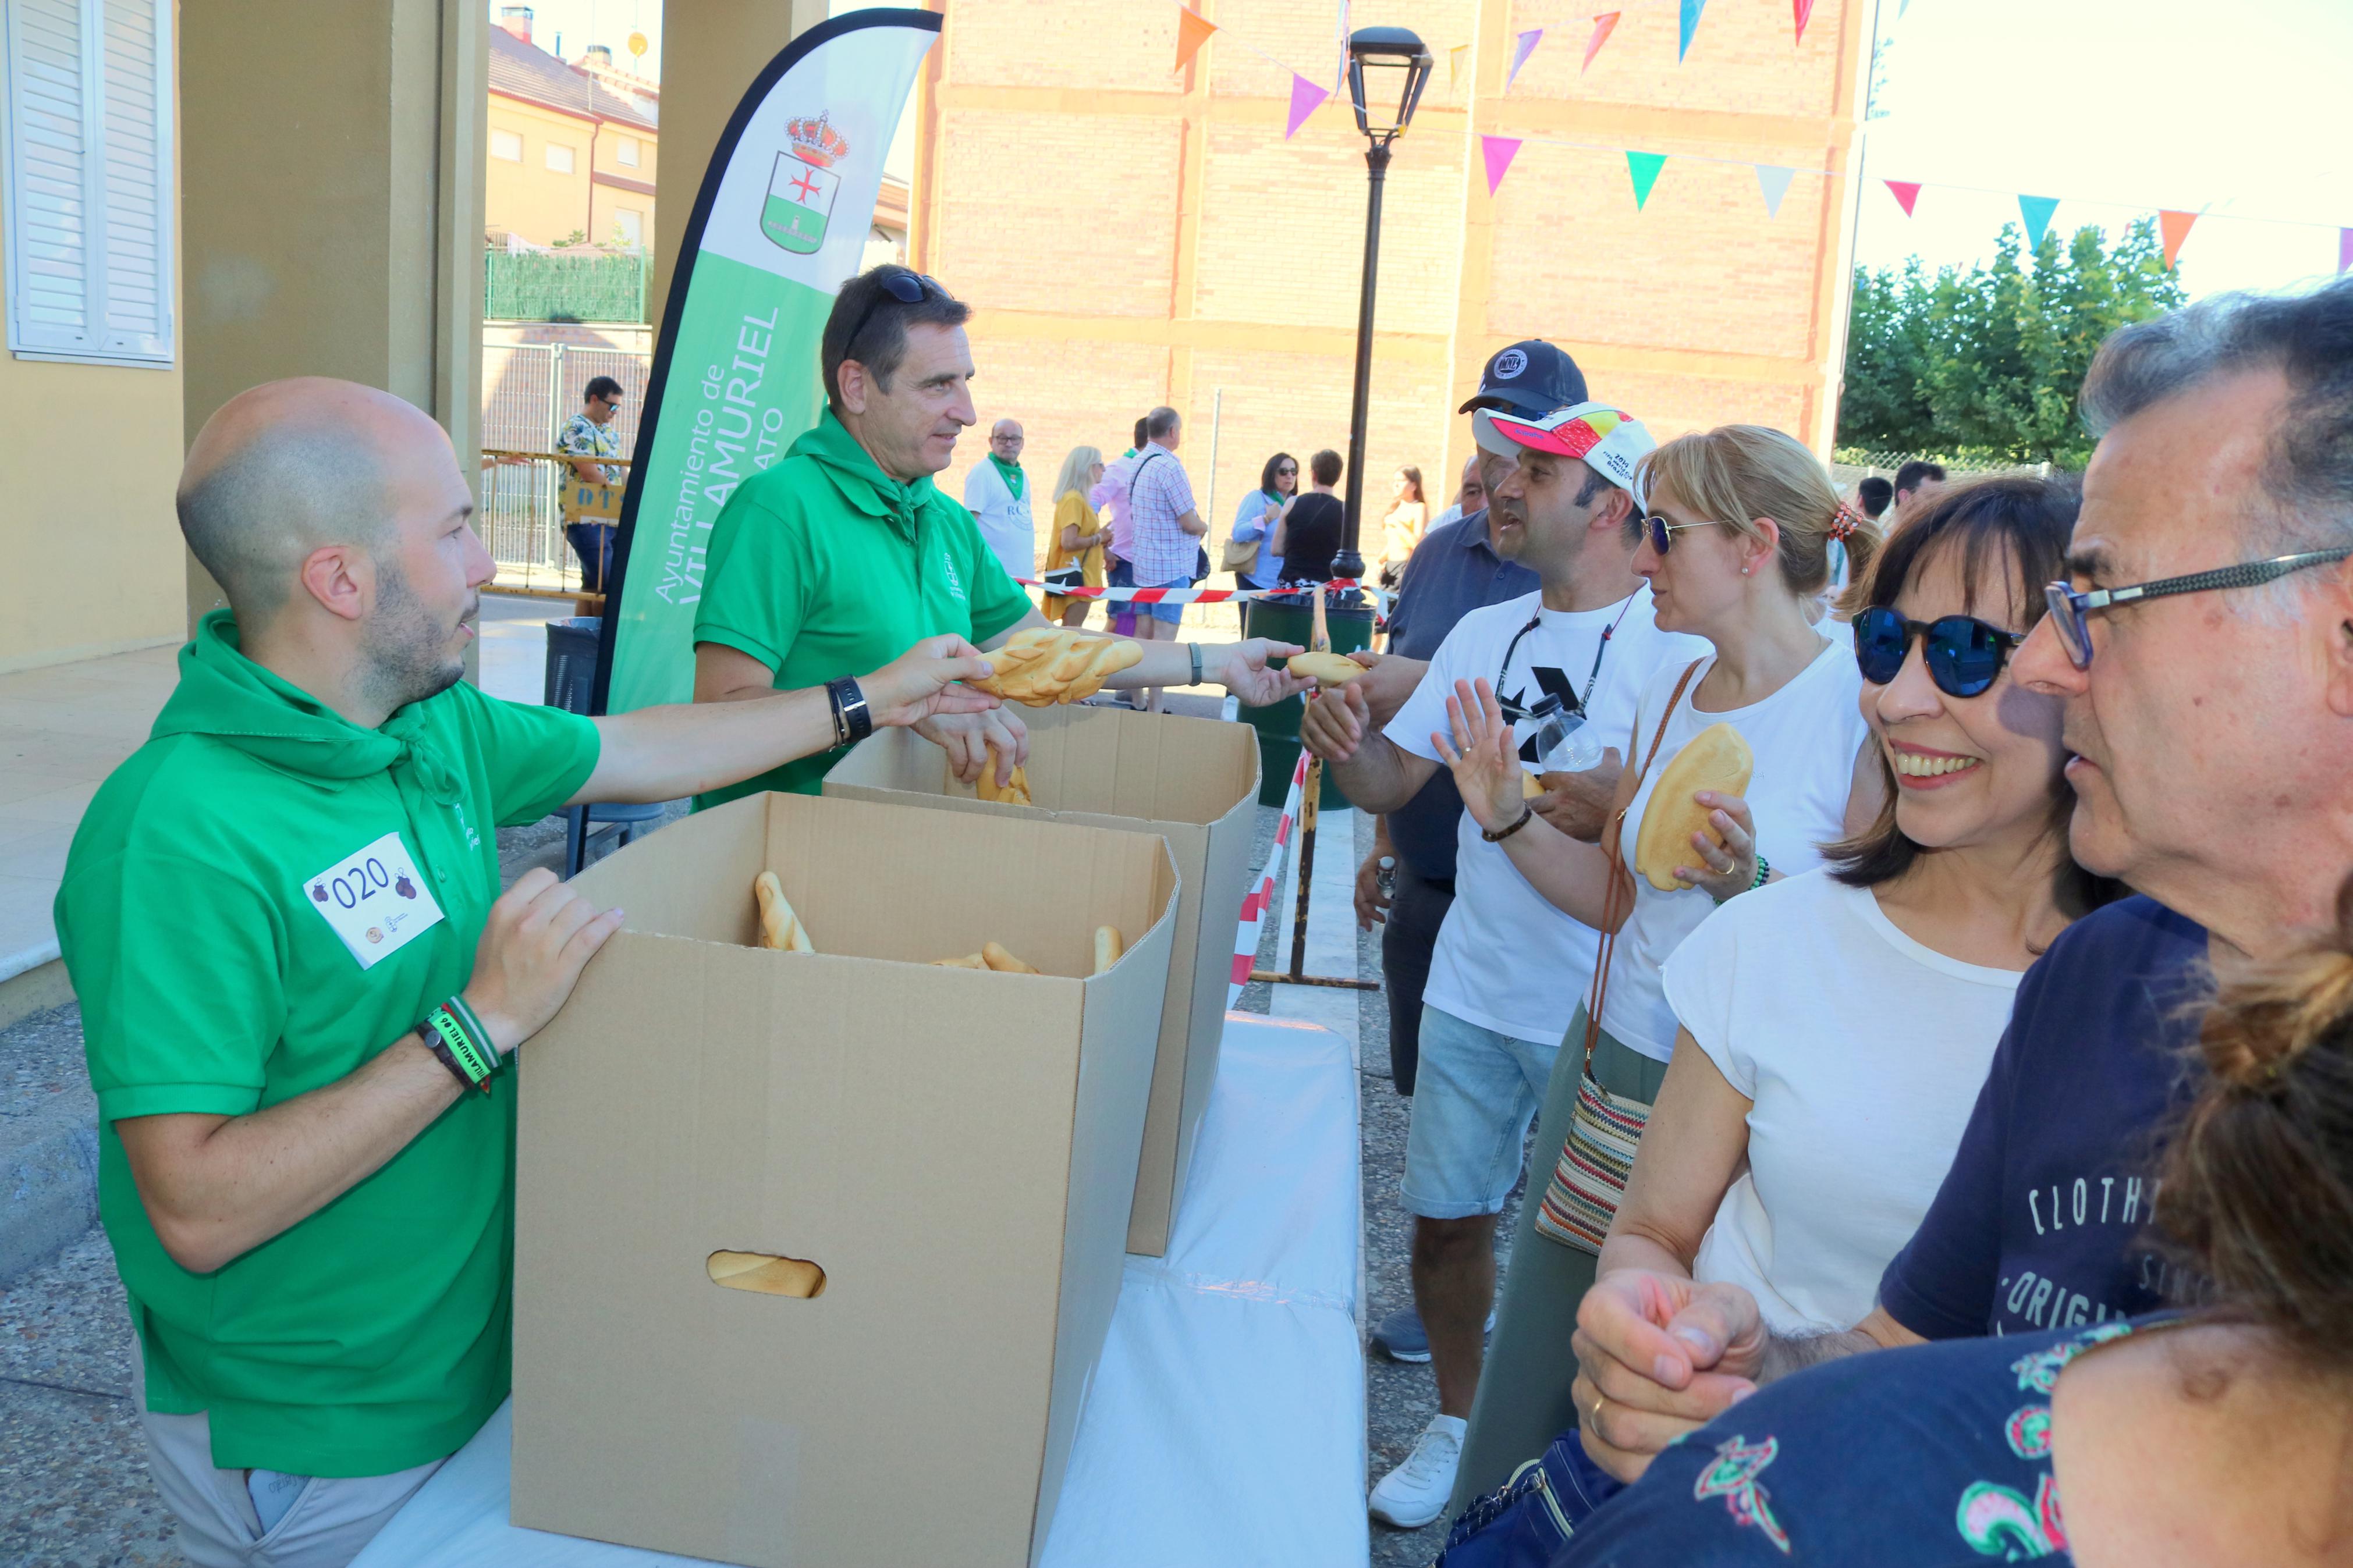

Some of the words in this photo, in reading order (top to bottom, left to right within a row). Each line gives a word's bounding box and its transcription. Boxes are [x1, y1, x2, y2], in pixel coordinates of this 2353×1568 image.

[655, 409, 714, 604] Ayuntamiento
[701, 365, 724, 400] de
[332, 858, 389, 909] 020
